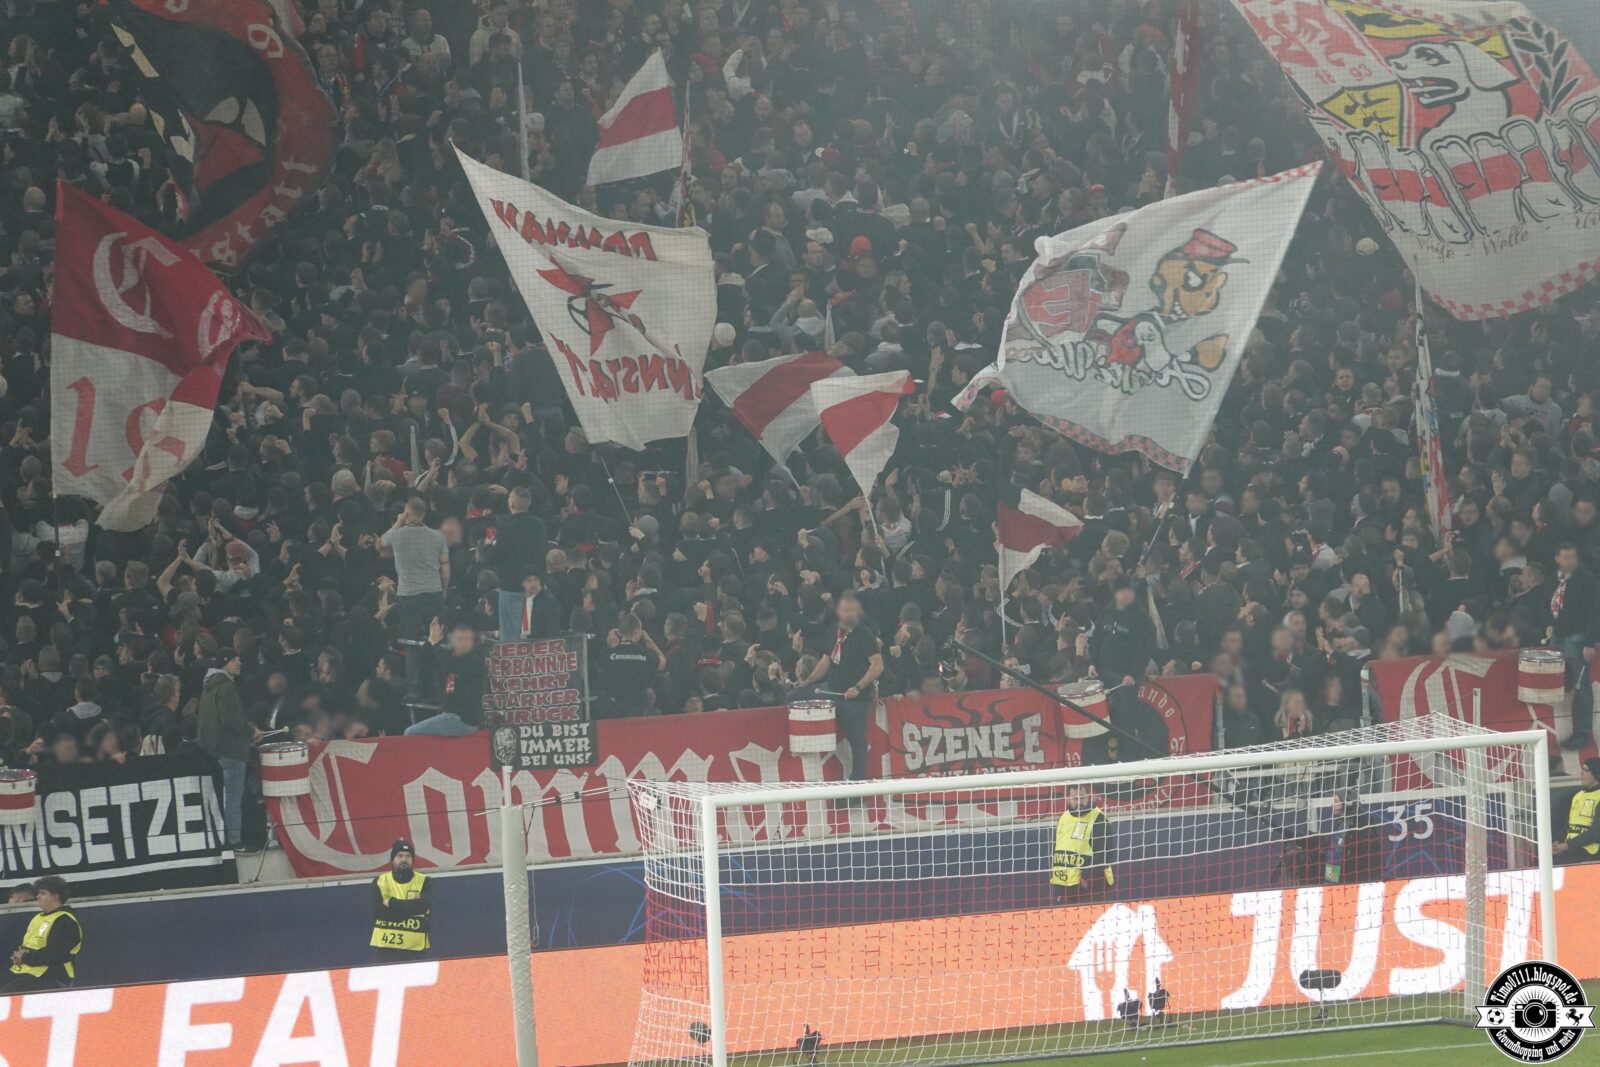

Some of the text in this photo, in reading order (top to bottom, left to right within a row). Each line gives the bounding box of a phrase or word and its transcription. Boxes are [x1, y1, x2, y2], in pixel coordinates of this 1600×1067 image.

[490, 639, 566, 658] JEDER
[490, 672, 570, 692] KEHRT
[519, 722, 590, 738] DU BIST
[520, 737, 592, 754] IMMER
[902, 712, 1045, 771] SZENE E
[1169, 736, 1186, 752] 97
[520, 752, 592, 766] BEI UNS!
[0, 775, 226, 872] MSETZEN
[1387, 803, 1434, 842] 35
[381, 932, 405, 946] 423
[1220, 867, 1565, 1010] JUST
[0, 961, 440, 1067] T EAT
